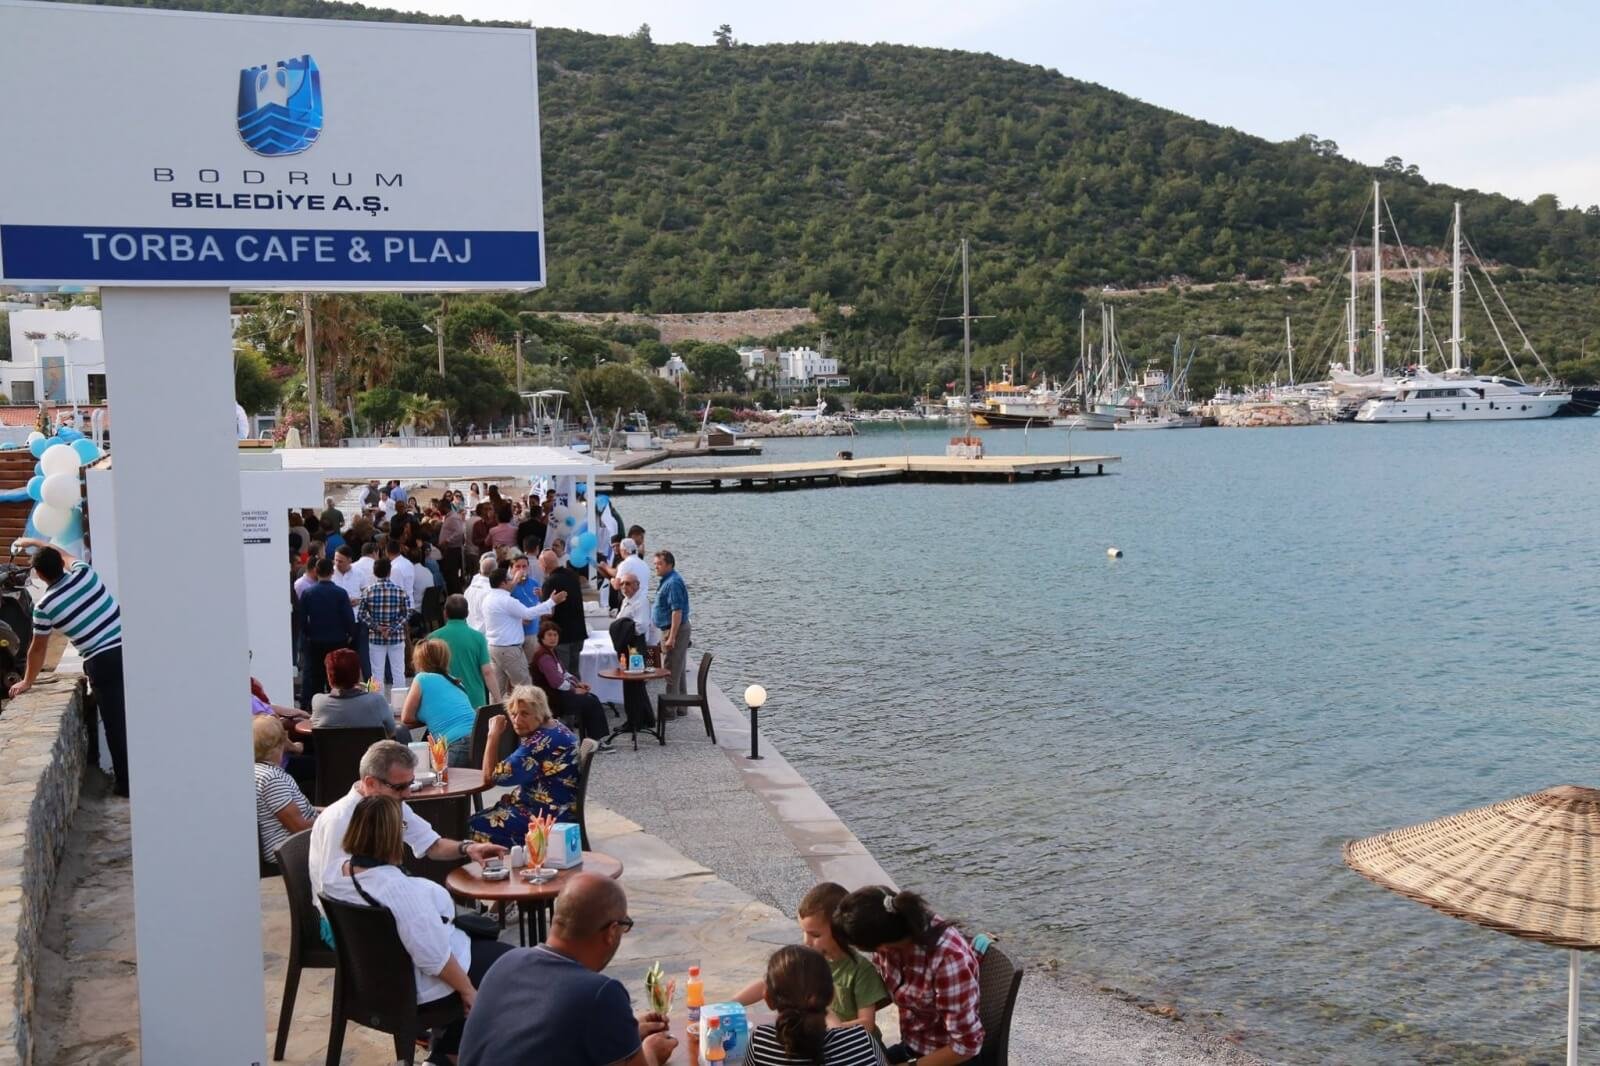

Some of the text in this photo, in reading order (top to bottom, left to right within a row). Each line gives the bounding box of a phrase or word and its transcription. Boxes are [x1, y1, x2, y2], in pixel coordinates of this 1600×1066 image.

[153, 168, 403, 187] BODRUM
[171, 190, 389, 216] BELEDİYE A.Ş.
[83, 233, 472, 264] TORBA CAFE & PLAJ
